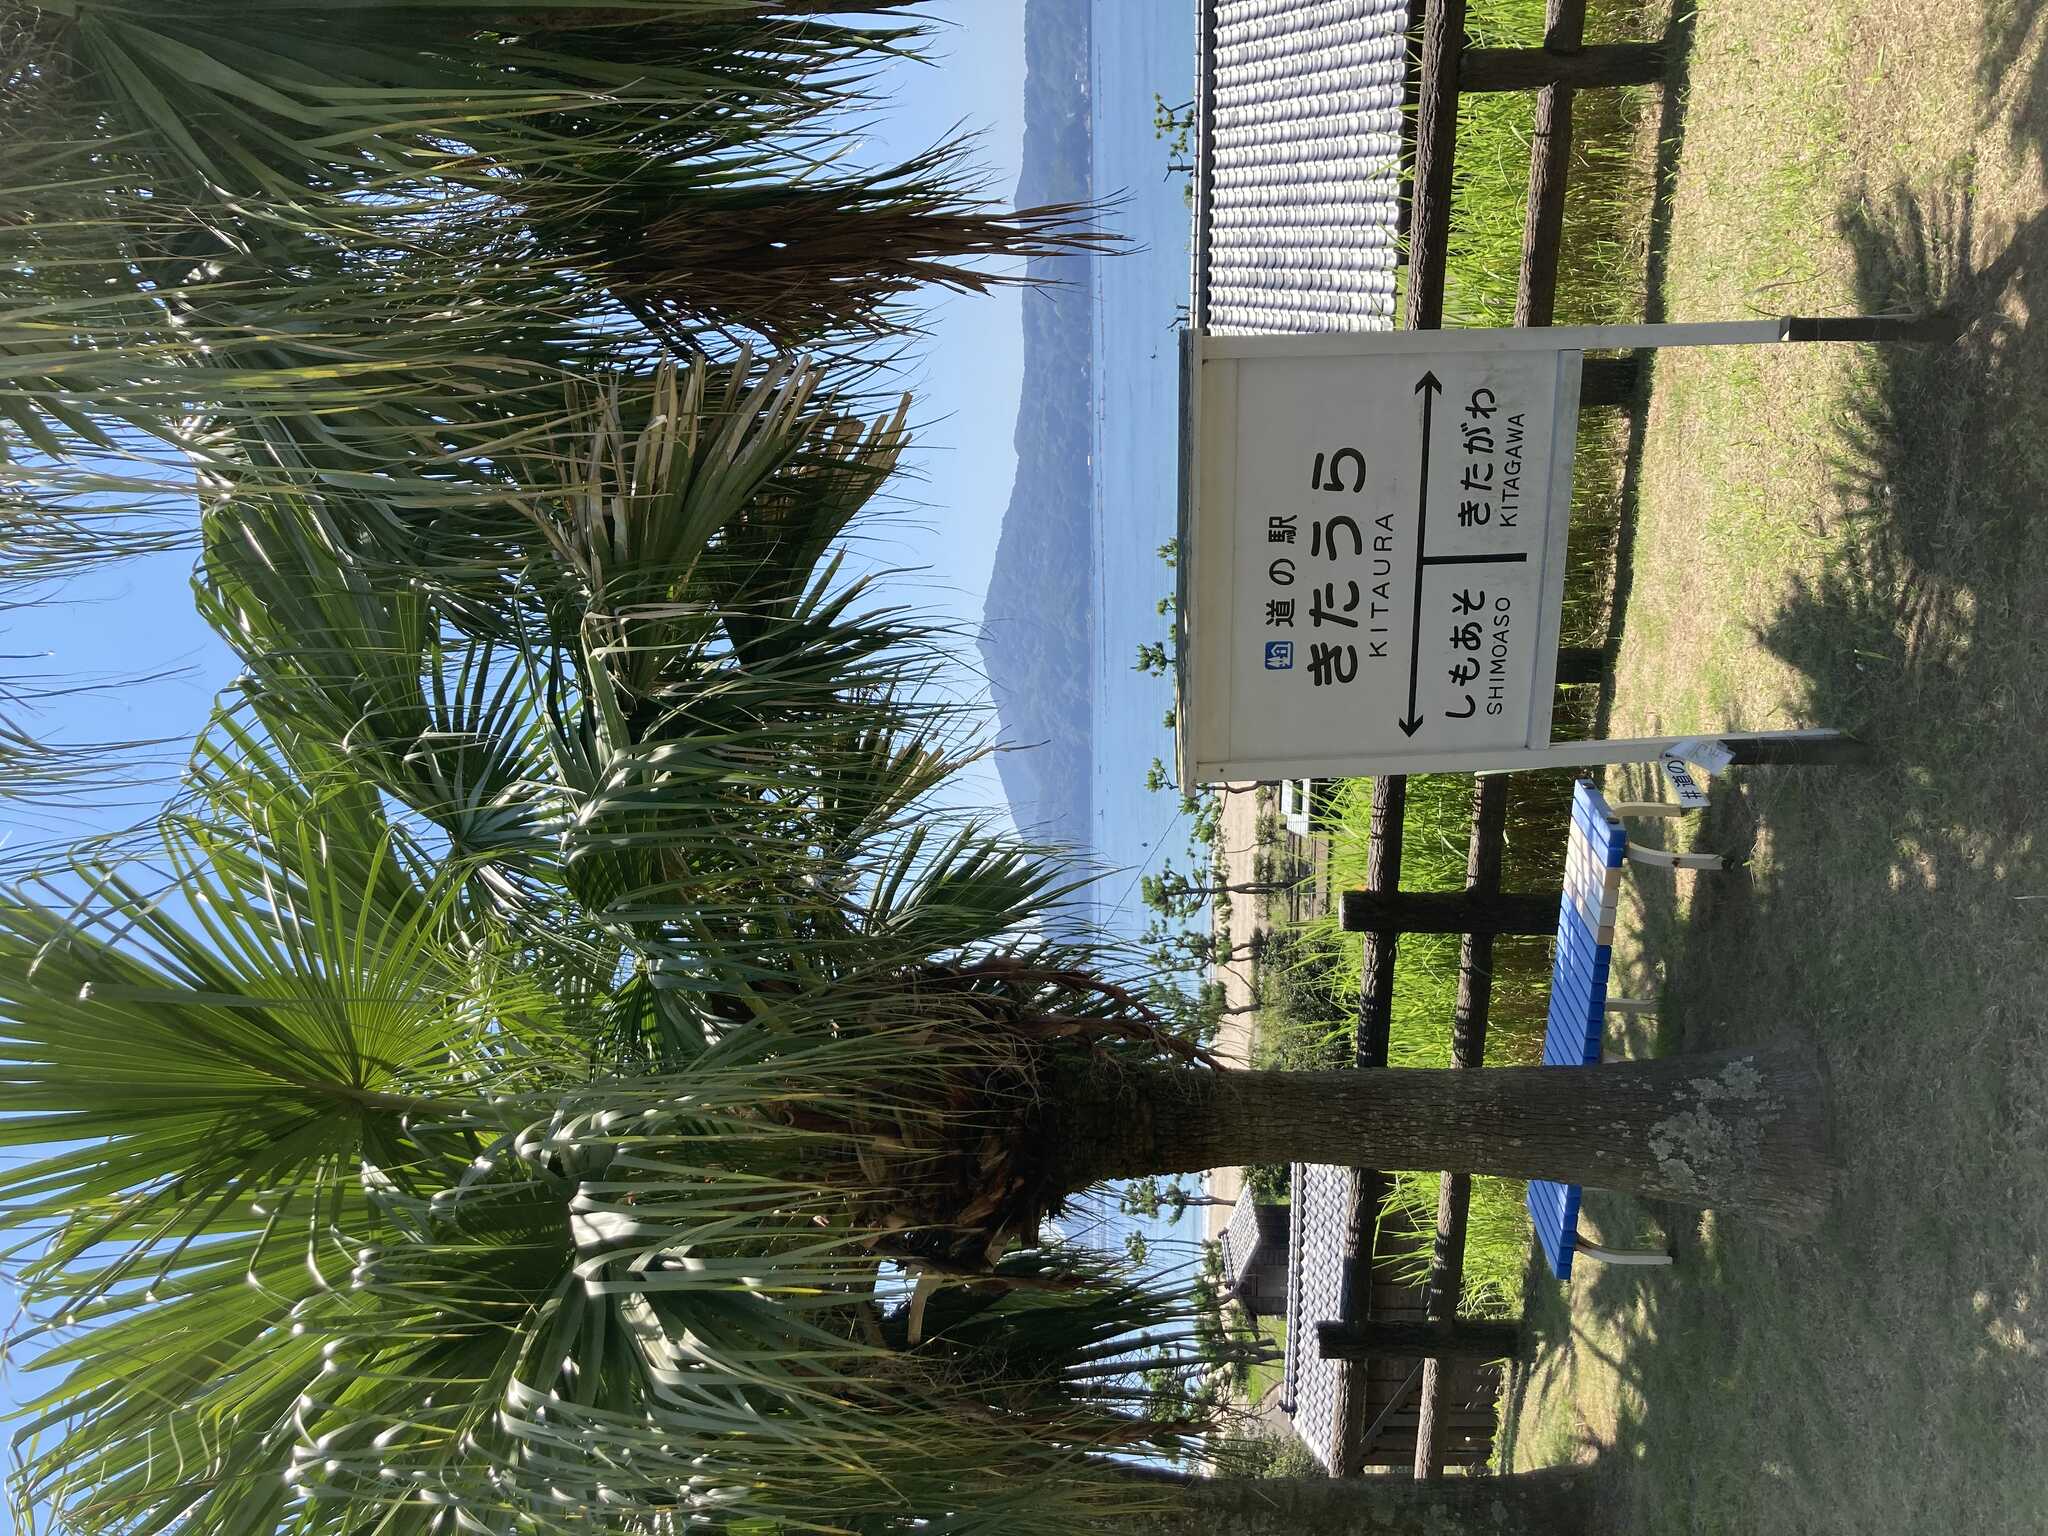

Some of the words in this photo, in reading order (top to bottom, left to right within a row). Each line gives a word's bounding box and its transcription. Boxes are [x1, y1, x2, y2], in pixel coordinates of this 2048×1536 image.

[1457, 387, 1498, 528] きたがわ
[1500, 413, 1526, 528] KITAGAWA
[1265, 514, 1298, 628] 道の駅
[1306, 447, 1367, 687] きたうら
[1368, 513, 1394, 658] KITAURA
[1444, 588, 1486, 719] しもあそ
[1486, 596, 1511, 716] SHIMOASO
[1665, 753, 1702, 800] #道の
